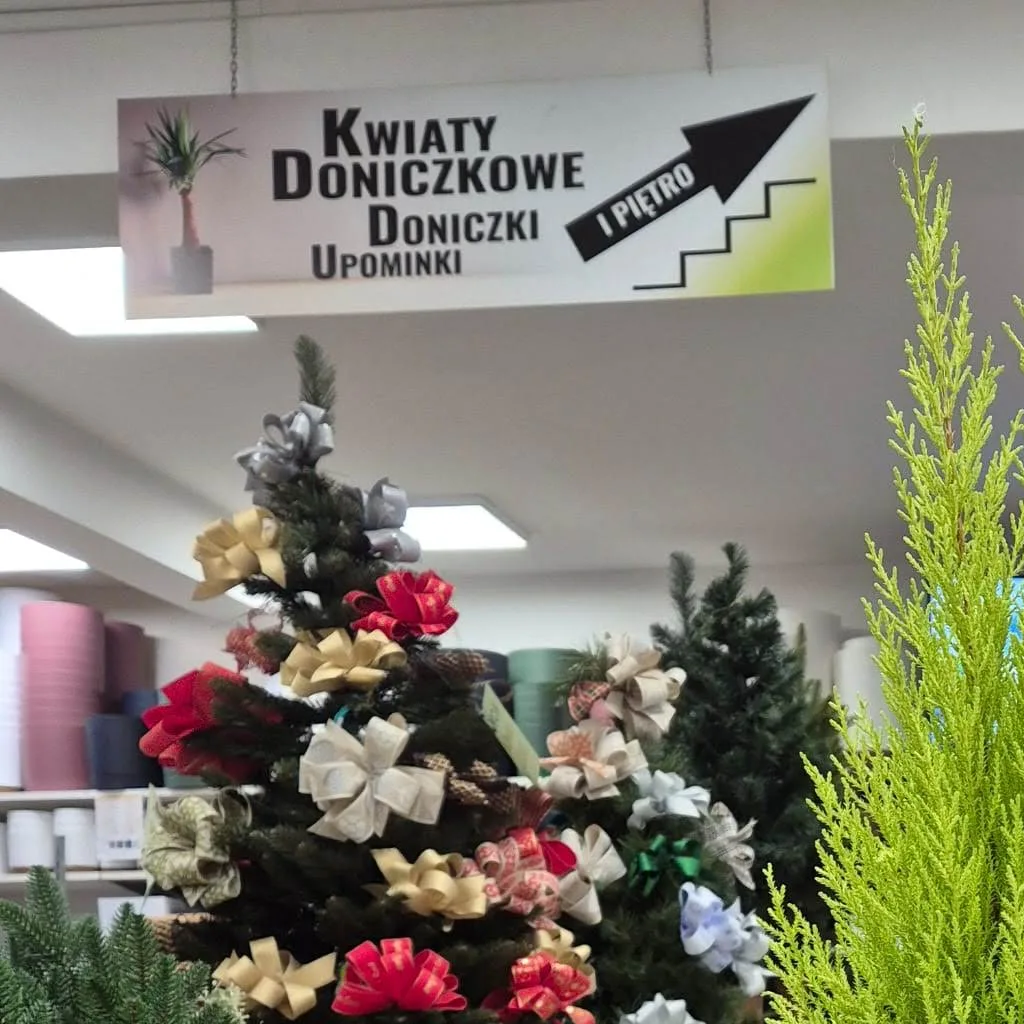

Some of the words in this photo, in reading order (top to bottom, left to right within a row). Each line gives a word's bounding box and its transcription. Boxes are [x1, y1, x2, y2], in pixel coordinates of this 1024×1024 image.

[323, 107, 497, 157] KWIATY
[272, 149, 585, 201] DONICZKOWE
[596, 212, 613, 238] I
[610, 162, 695, 229] PIĘTRO
[368, 204, 539, 247] DONICZKI
[311, 244, 462, 280] UPOMINKI
